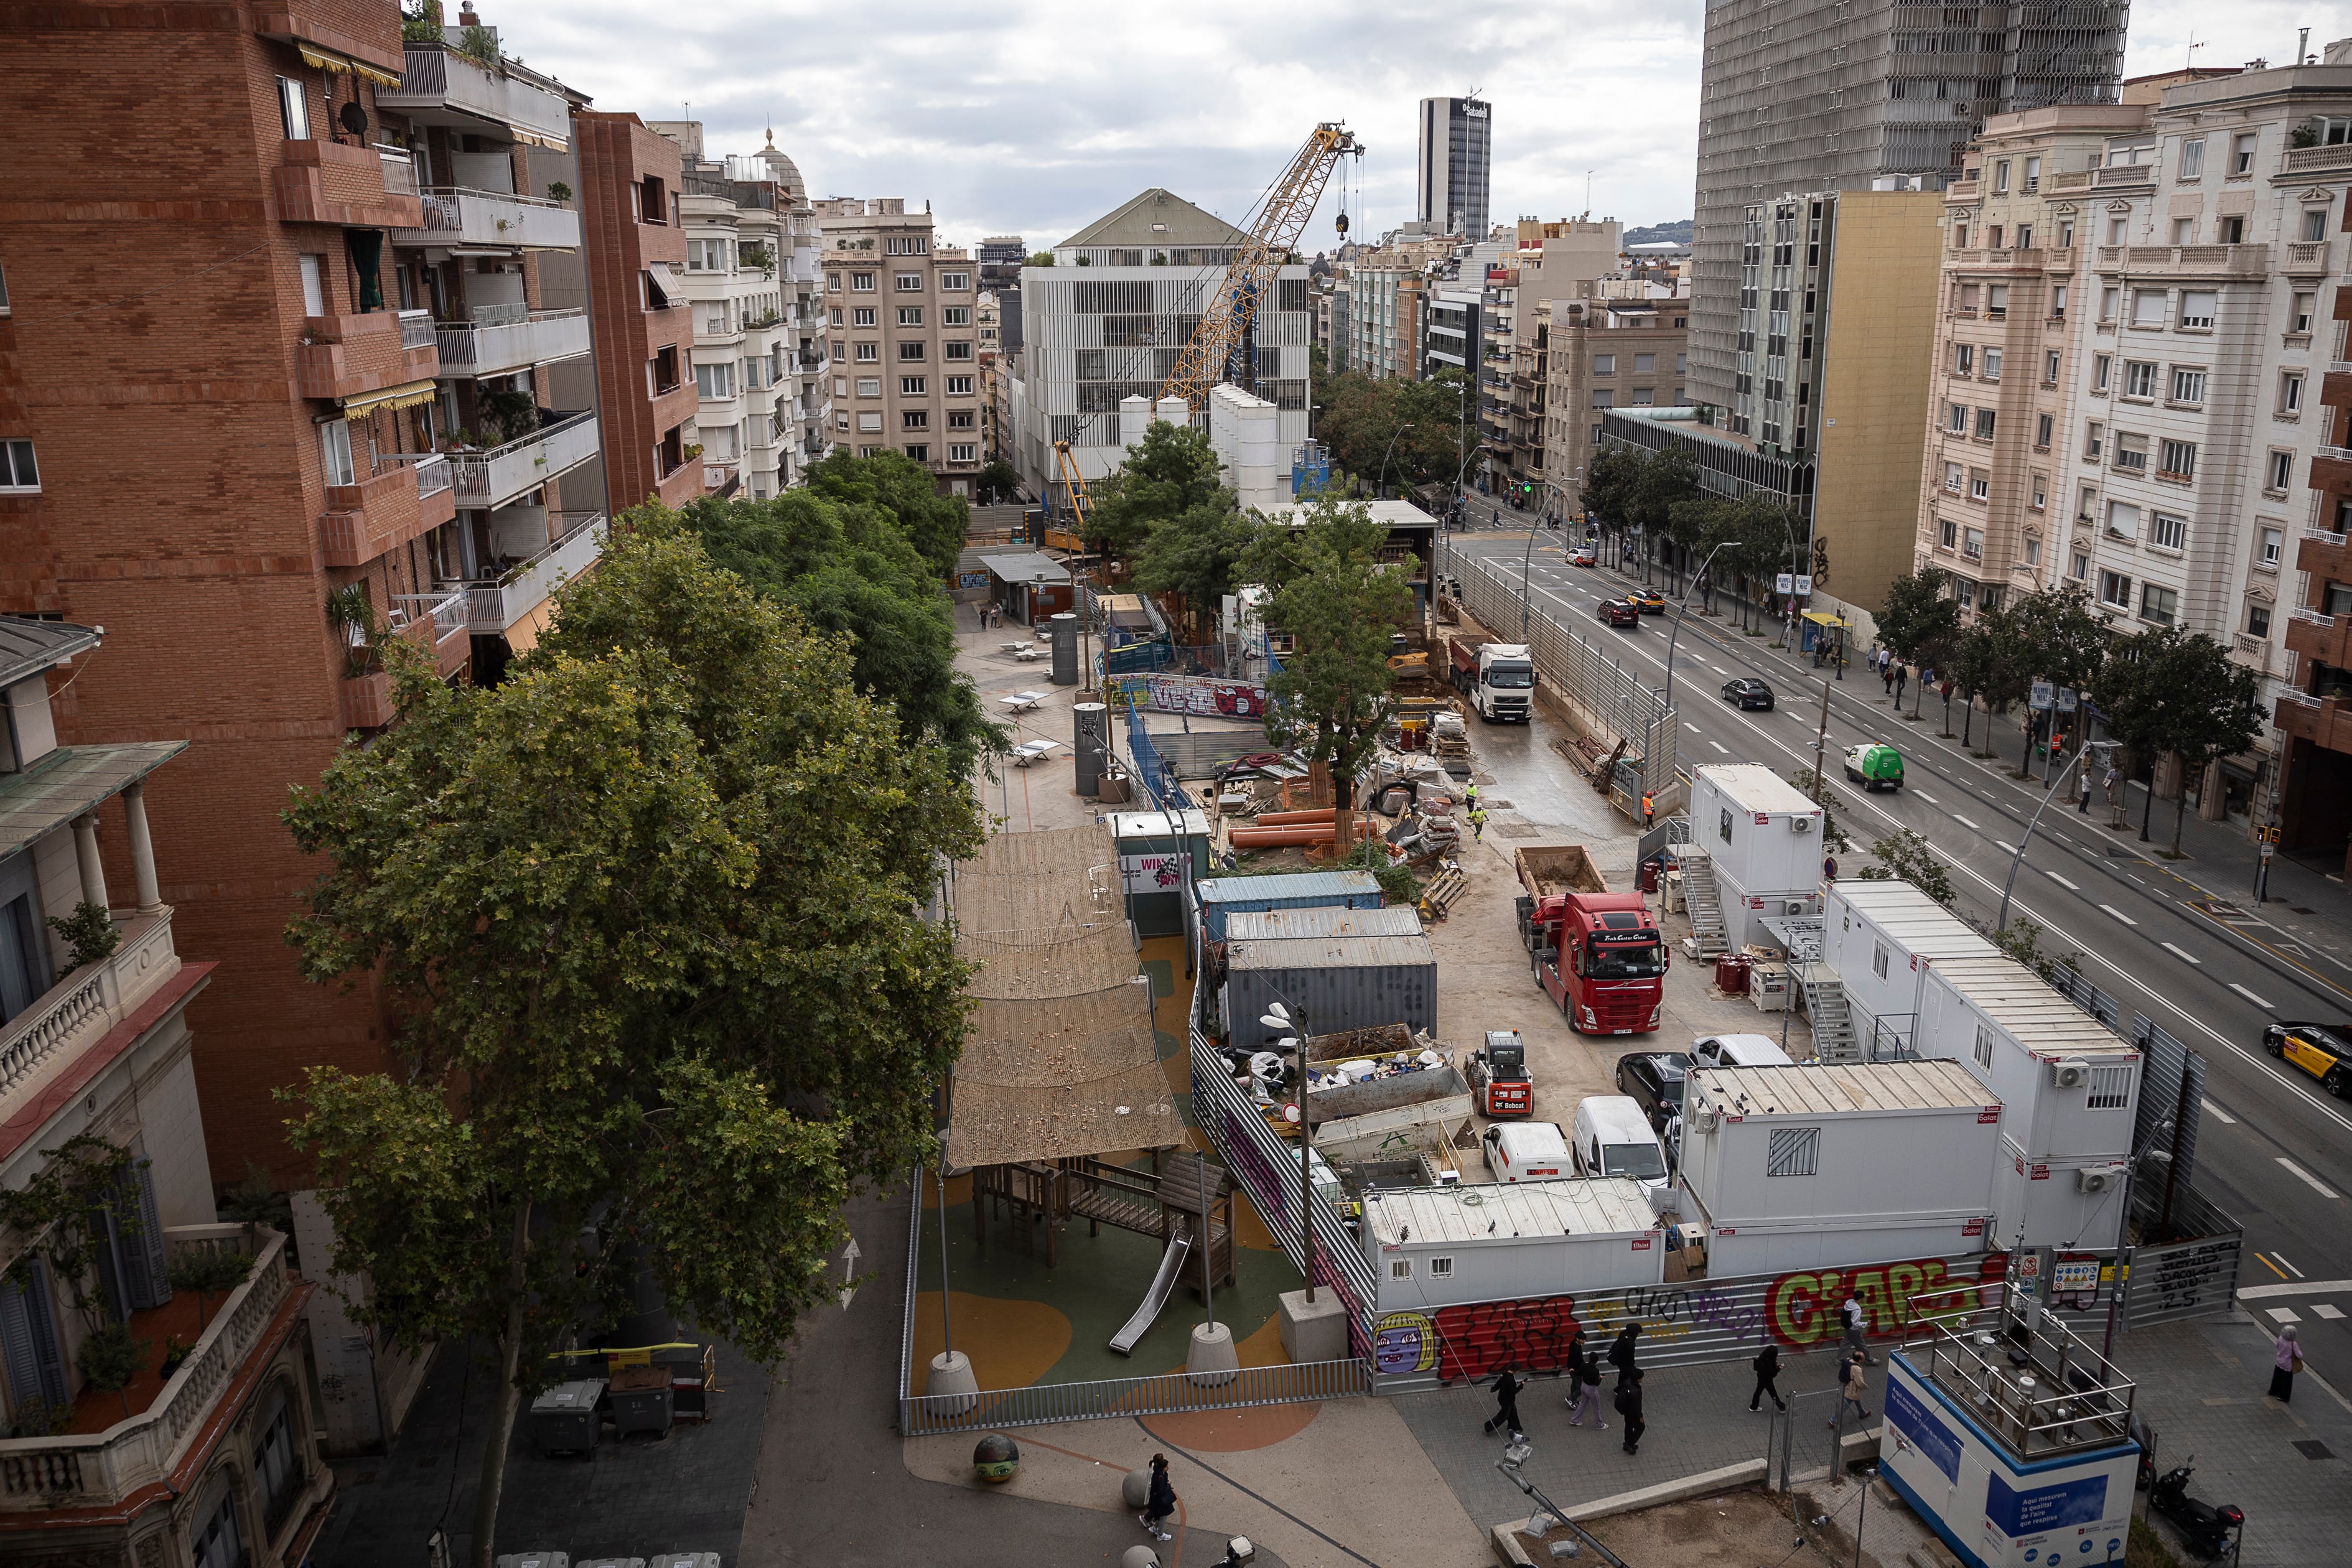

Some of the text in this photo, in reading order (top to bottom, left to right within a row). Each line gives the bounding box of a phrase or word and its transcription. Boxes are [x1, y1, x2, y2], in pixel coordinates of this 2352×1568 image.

[1466, 105, 1488, 118] Sabadell
[2033, 686, 2051, 696] MAMMA
[2037, 694, 2048, 702] MIA!
[1141, 859, 1164, 870] WIN
[1373, 1144, 1416, 1159] H-ZERO
[1903, 1397, 1922, 1417] mesurem
[1897, 1399, 1912, 1416] qualitat
[1912, 1414, 1918, 1422] de
[1930, 1430, 1938, 1441] que
[2038, 1492, 2067, 1502] mesurem
[2028, 1501, 2052, 1511] qualitat
[2020, 1514, 2058, 1528] que respires
